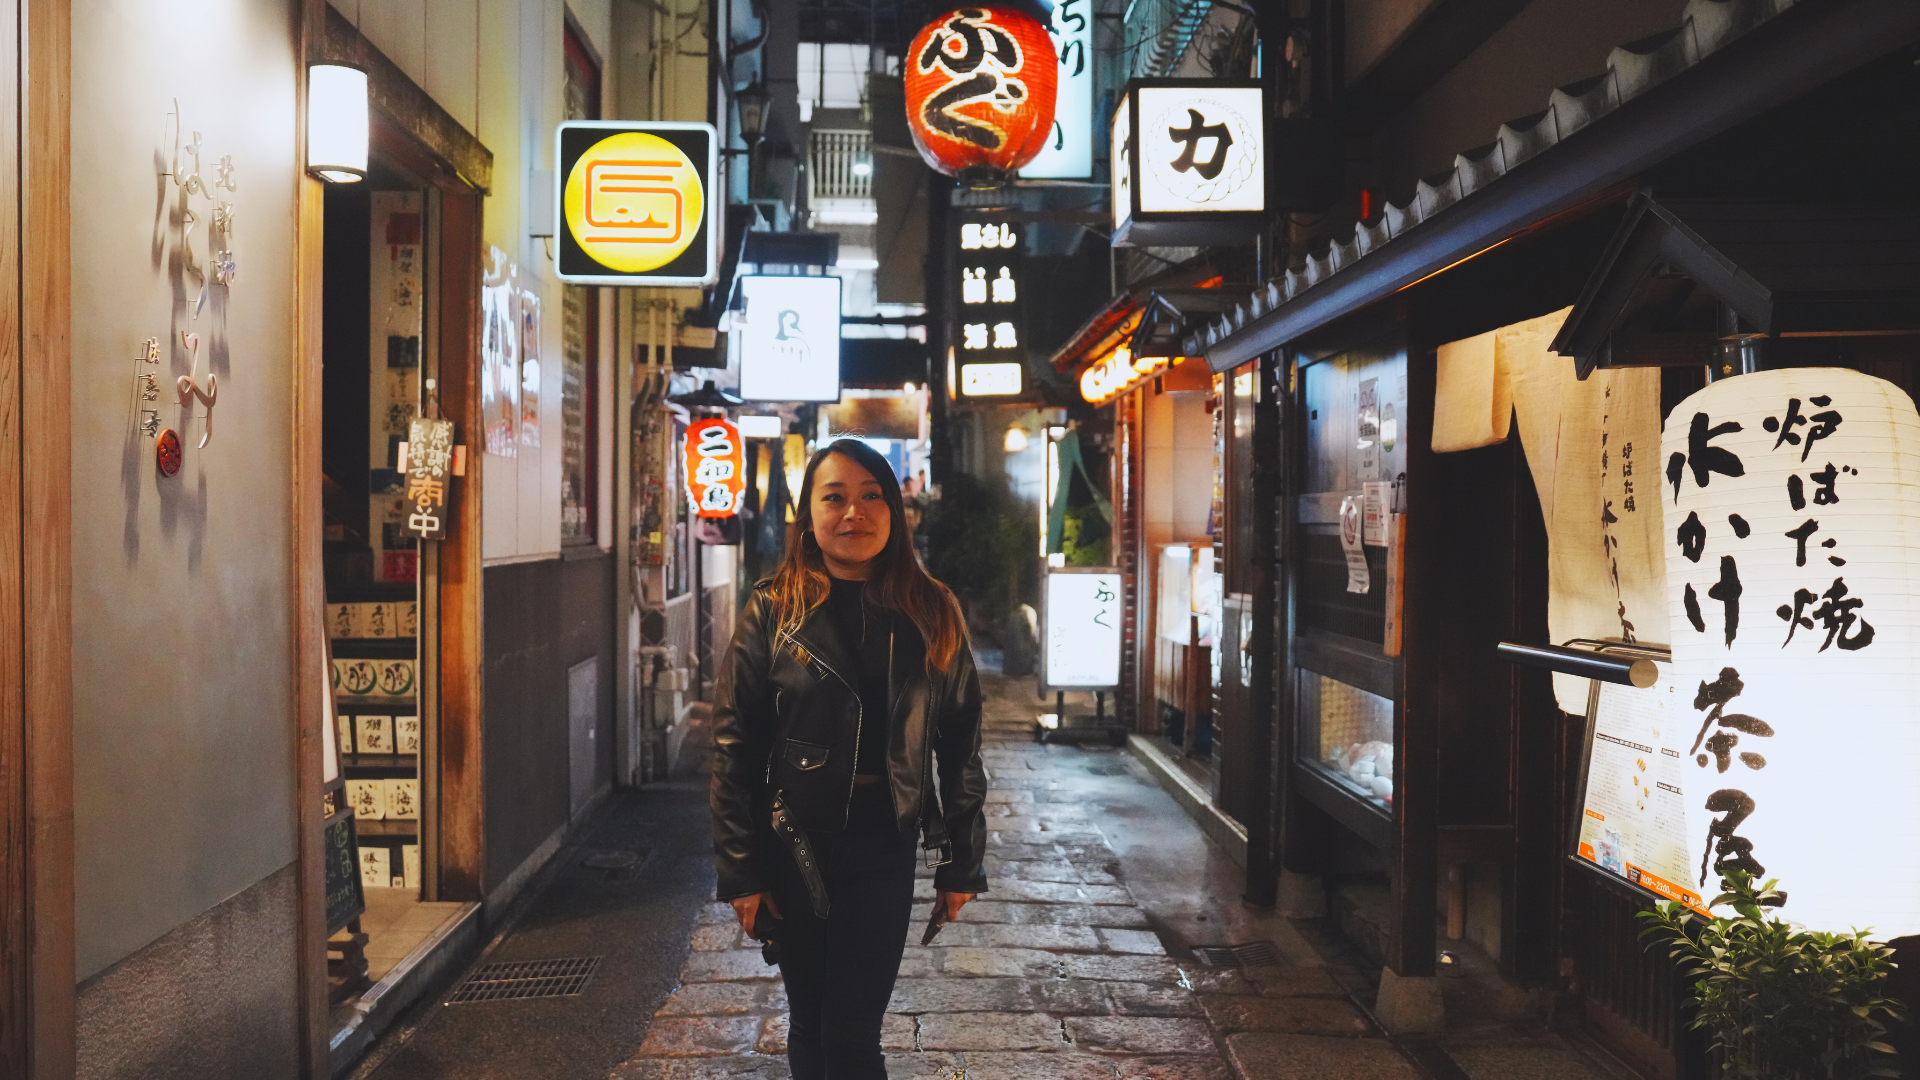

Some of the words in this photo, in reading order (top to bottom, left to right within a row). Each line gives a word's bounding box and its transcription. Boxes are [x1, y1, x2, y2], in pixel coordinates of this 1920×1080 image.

[917, 7, 1028, 152] ふぐ
[1762, 394, 1876, 653] 炉ばた焼
[1667, 411, 1788, 908] 水かけ茶屋
[358, 783, 376, 816] 八海山
[396, 782, 414, 816] 八海山
